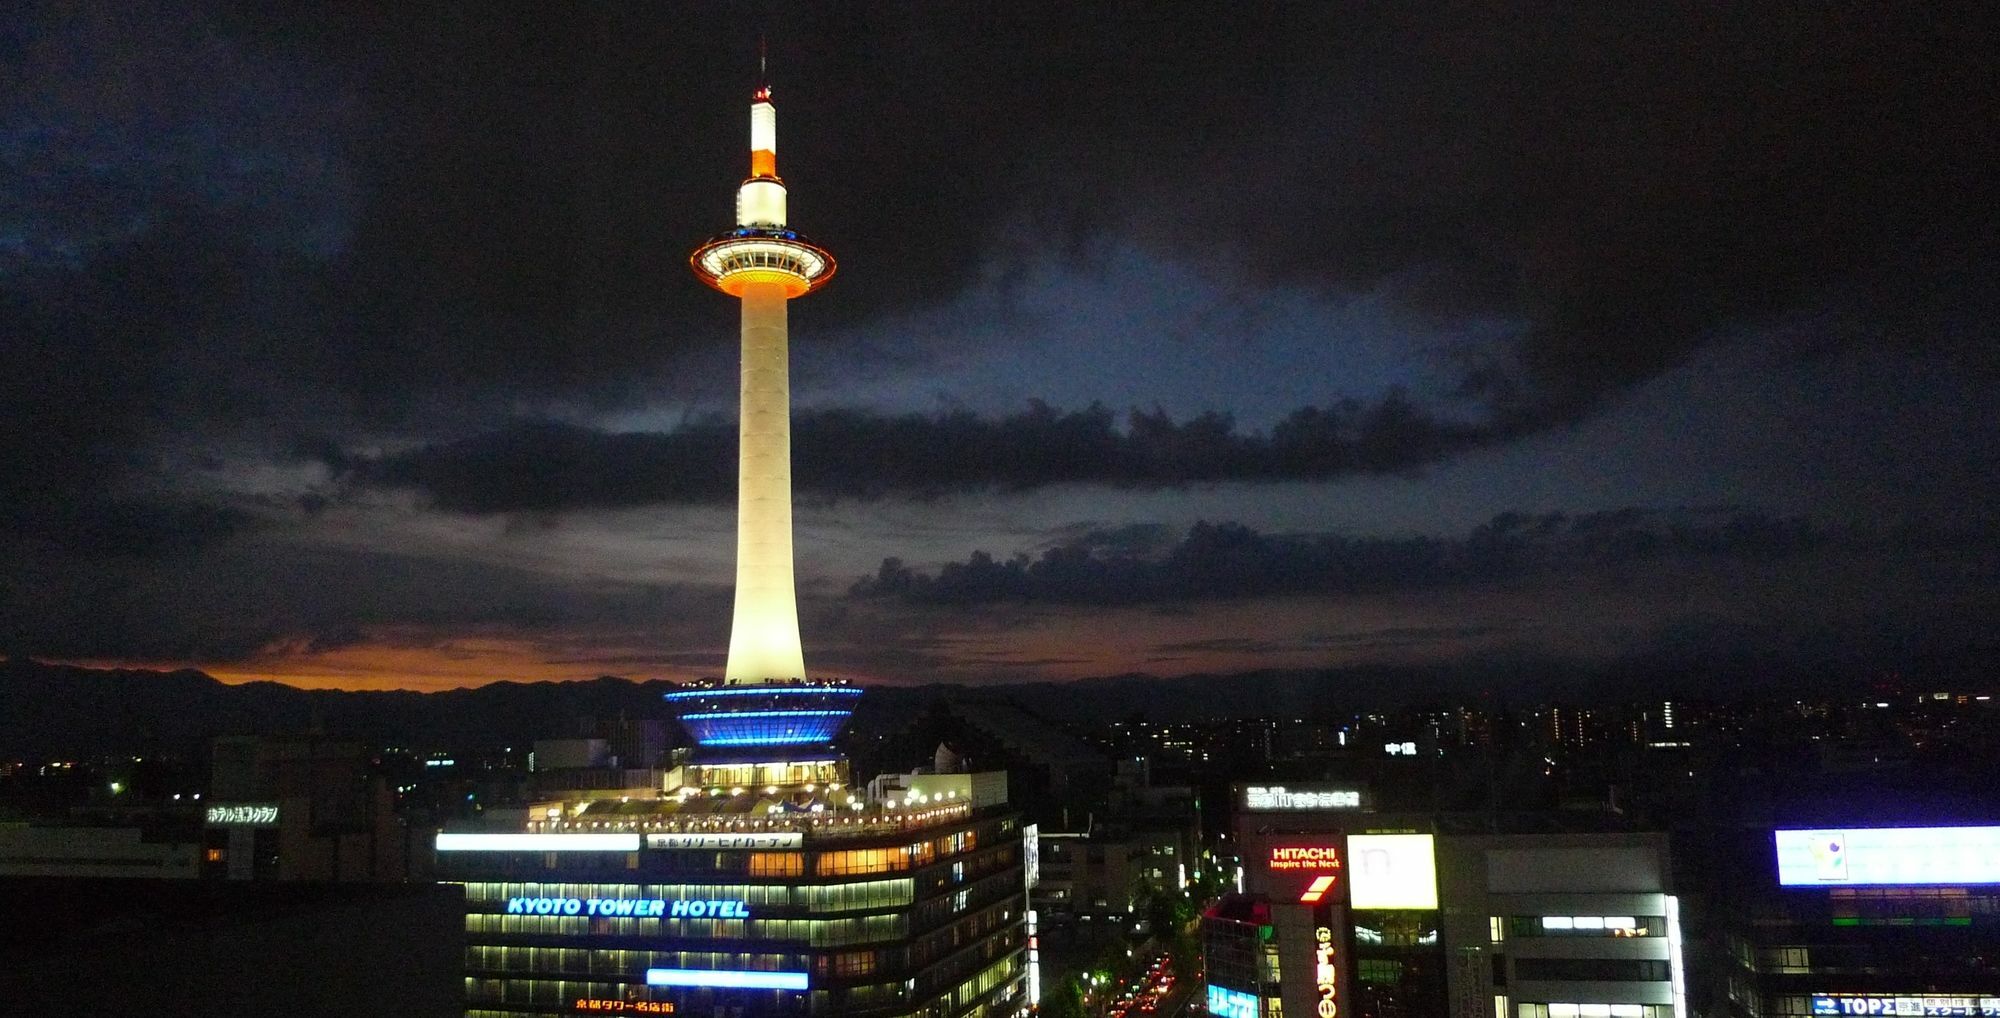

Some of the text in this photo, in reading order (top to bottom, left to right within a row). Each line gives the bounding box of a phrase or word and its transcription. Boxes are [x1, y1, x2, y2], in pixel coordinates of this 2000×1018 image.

[1273, 848, 1335, 859] HITACHI
[1270, 859, 1340, 869] Inspire the Next
[508, 898, 750, 918] KYOTO TOWER HOTEL
